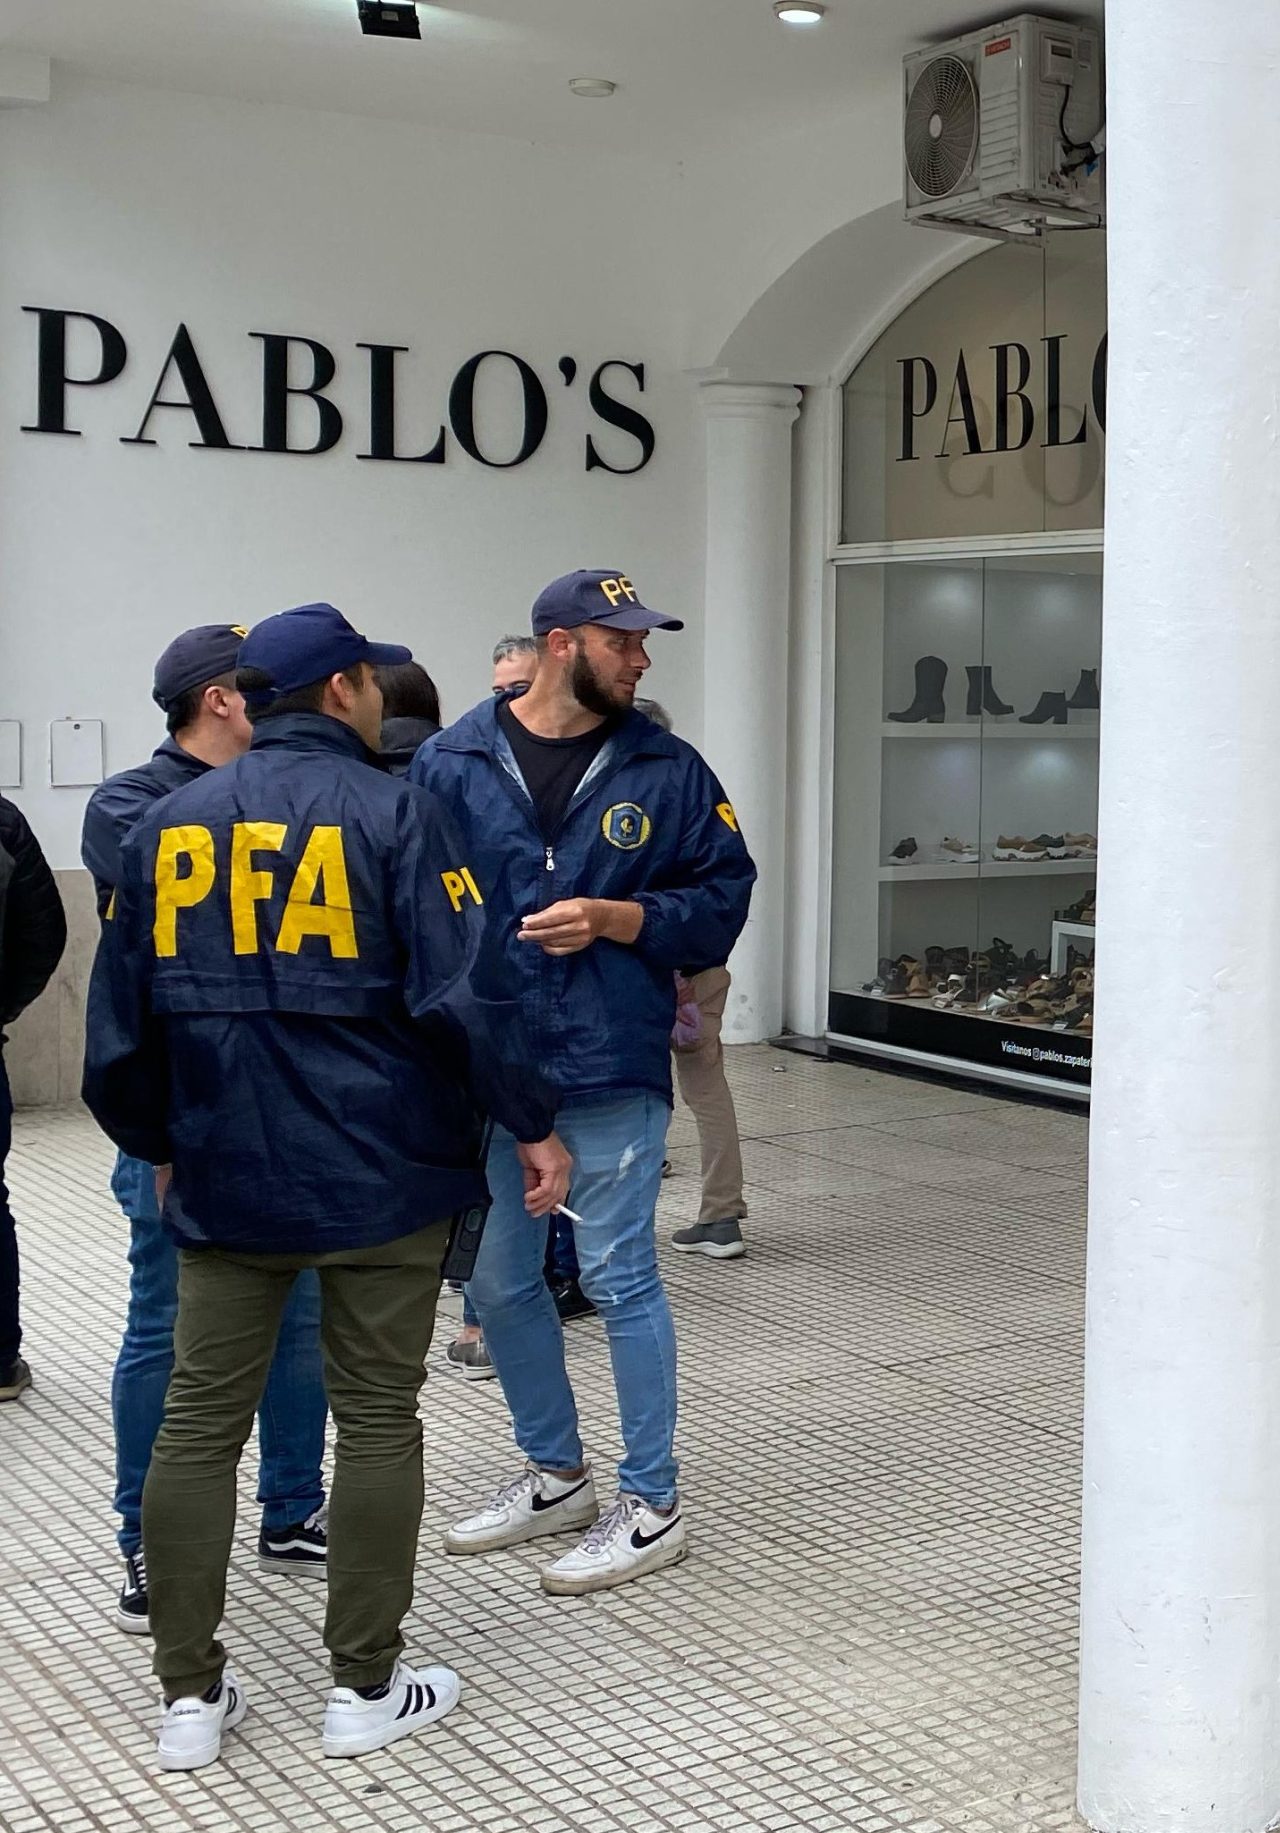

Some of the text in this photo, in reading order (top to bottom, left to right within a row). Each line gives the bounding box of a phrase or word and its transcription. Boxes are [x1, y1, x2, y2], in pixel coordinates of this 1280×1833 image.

[20, 305, 656, 474] PABLO'S
[896, 331, 1107, 462] PABL
[600, 576, 636, 607] PF
[153, 821, 359, 959] PFA
